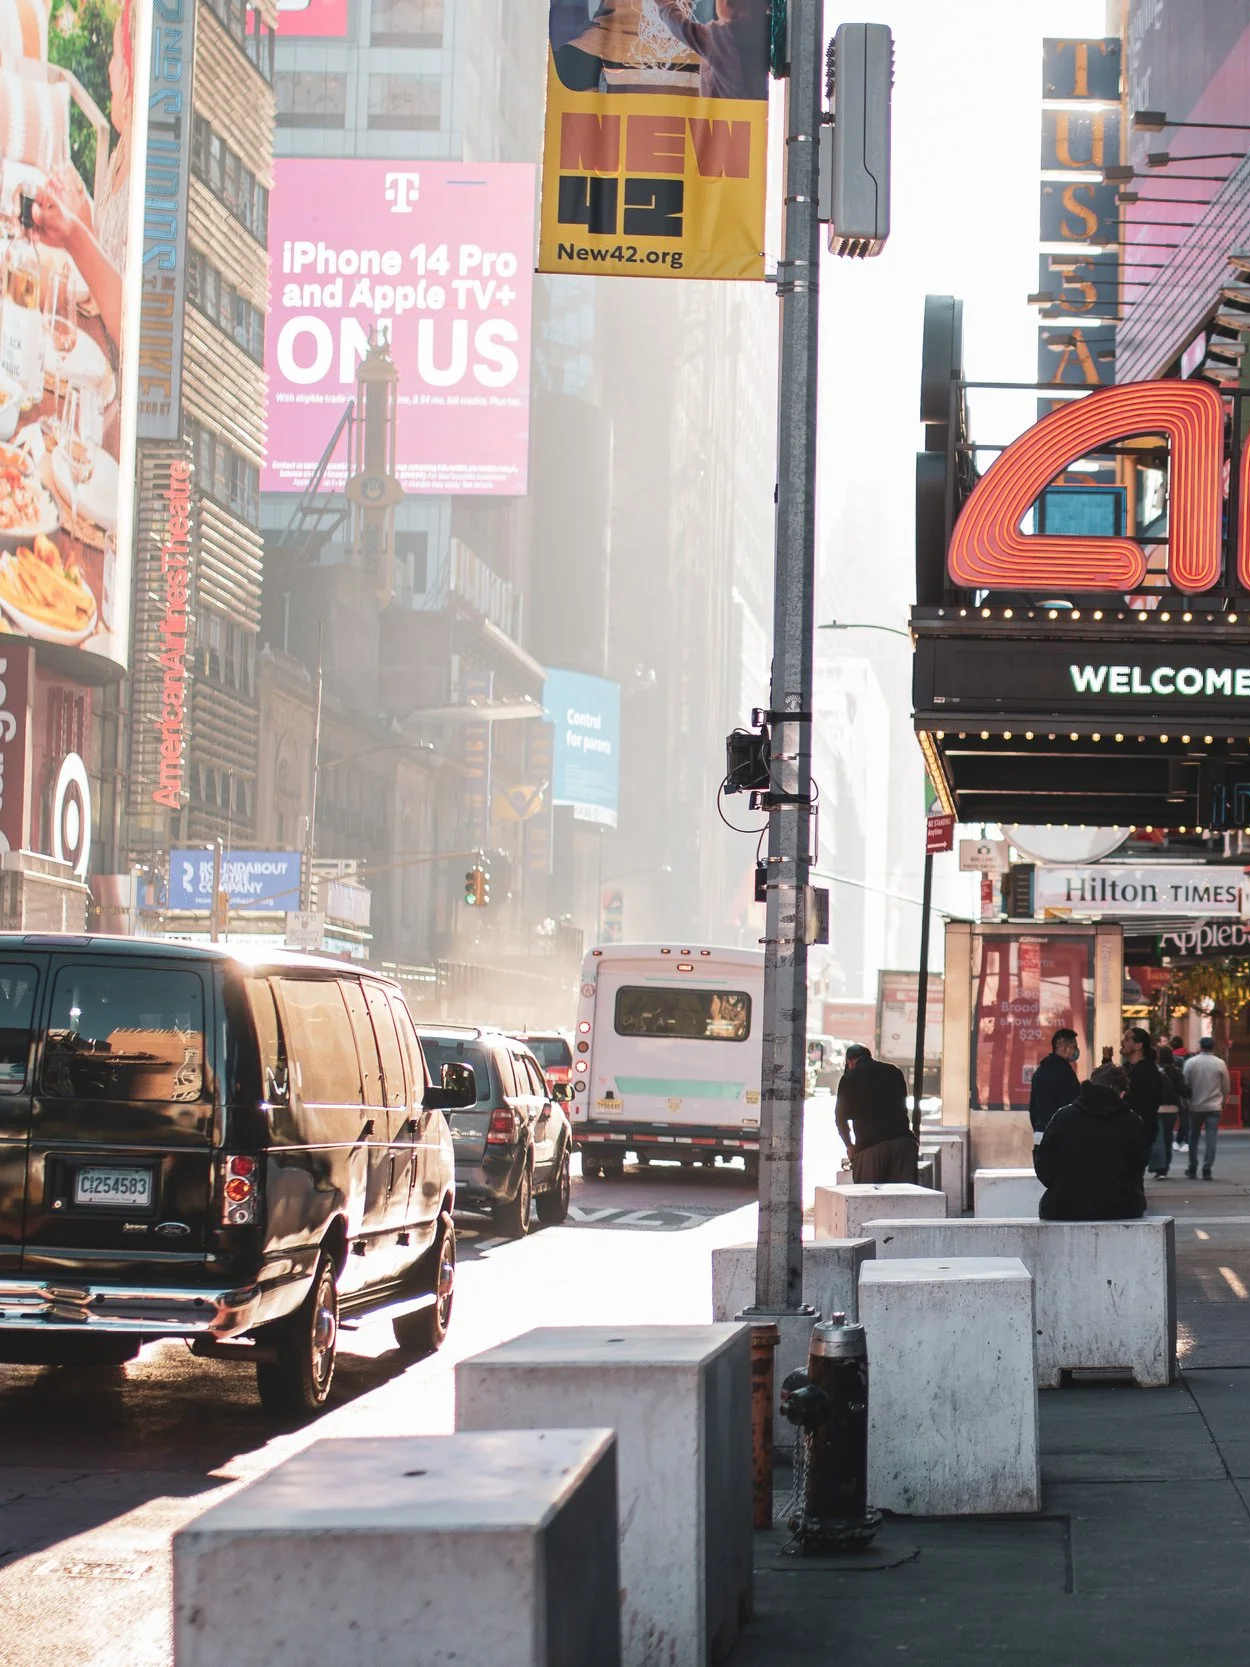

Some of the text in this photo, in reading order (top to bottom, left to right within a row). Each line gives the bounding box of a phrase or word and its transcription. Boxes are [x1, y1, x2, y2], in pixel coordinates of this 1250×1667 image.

[560, 112, 751, 179] NEW
[385, 172, 420, 213] T
[557, 175, 685, 238] 42
[282, 241, 518, 277] iPhone 14 Pro
[557, 243, 683, 270] New42.org
[282, 277, 517, 315] and Apple TV+
[276, 315, 519, 388] ON US
[566, 708, 601, 729] Control
[566, 730, 583, 747] for
[199, 873, 250, 885] THATRE
[1065, 876, 1237, 903] Hilton TIMES
[1001, 1002, 1065, 1015] Broadway
[1019, 1028, 1045, 1041] $29.
